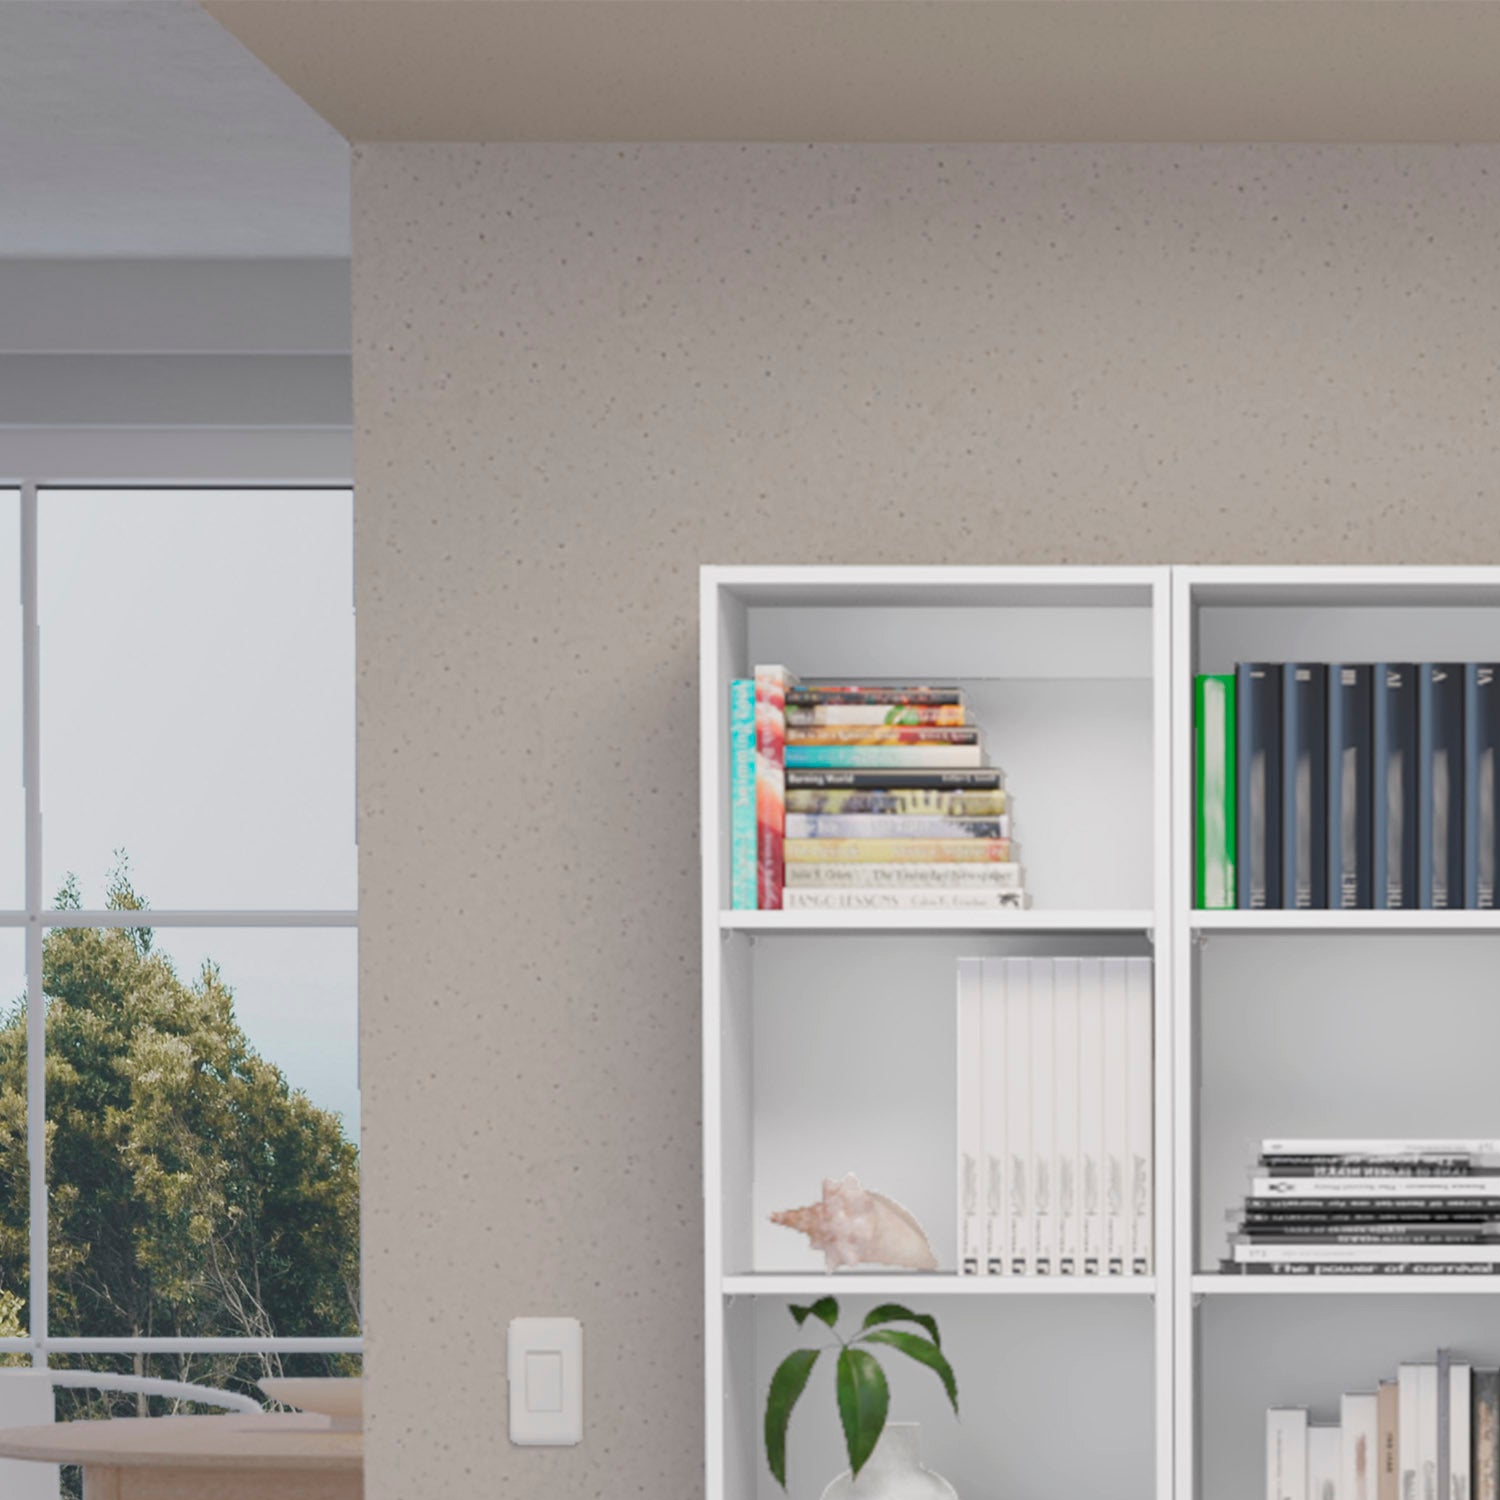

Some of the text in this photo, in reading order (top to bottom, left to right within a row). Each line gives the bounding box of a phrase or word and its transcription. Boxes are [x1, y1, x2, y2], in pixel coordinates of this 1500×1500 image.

[1341, 669, 1357, 685] III
[1387, 671, 1403, 688] IV
[1432, 670, 1448, 683] V
[1477, 669, 1494, 686] VI
[1271, 1262, 1493, 1275] The power of carnival
